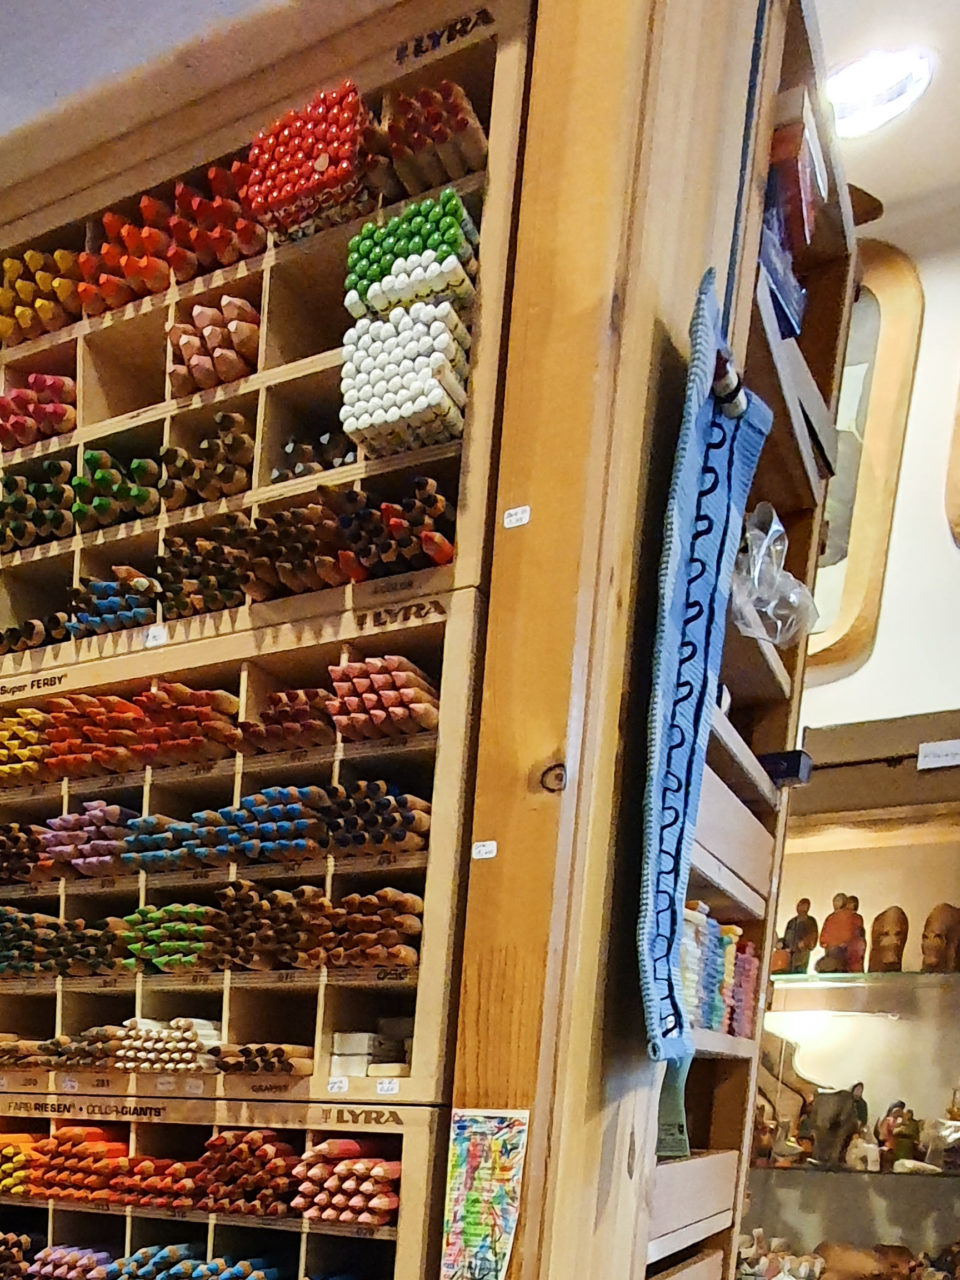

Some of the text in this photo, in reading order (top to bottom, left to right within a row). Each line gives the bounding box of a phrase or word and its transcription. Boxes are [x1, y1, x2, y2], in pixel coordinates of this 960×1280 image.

[413, 8, 496, 58] LYRA
[373, 600, 447, 627] LYRA
[0, 684, 28, 696] Super
[337, 1109, 404, 1125] LYRA
